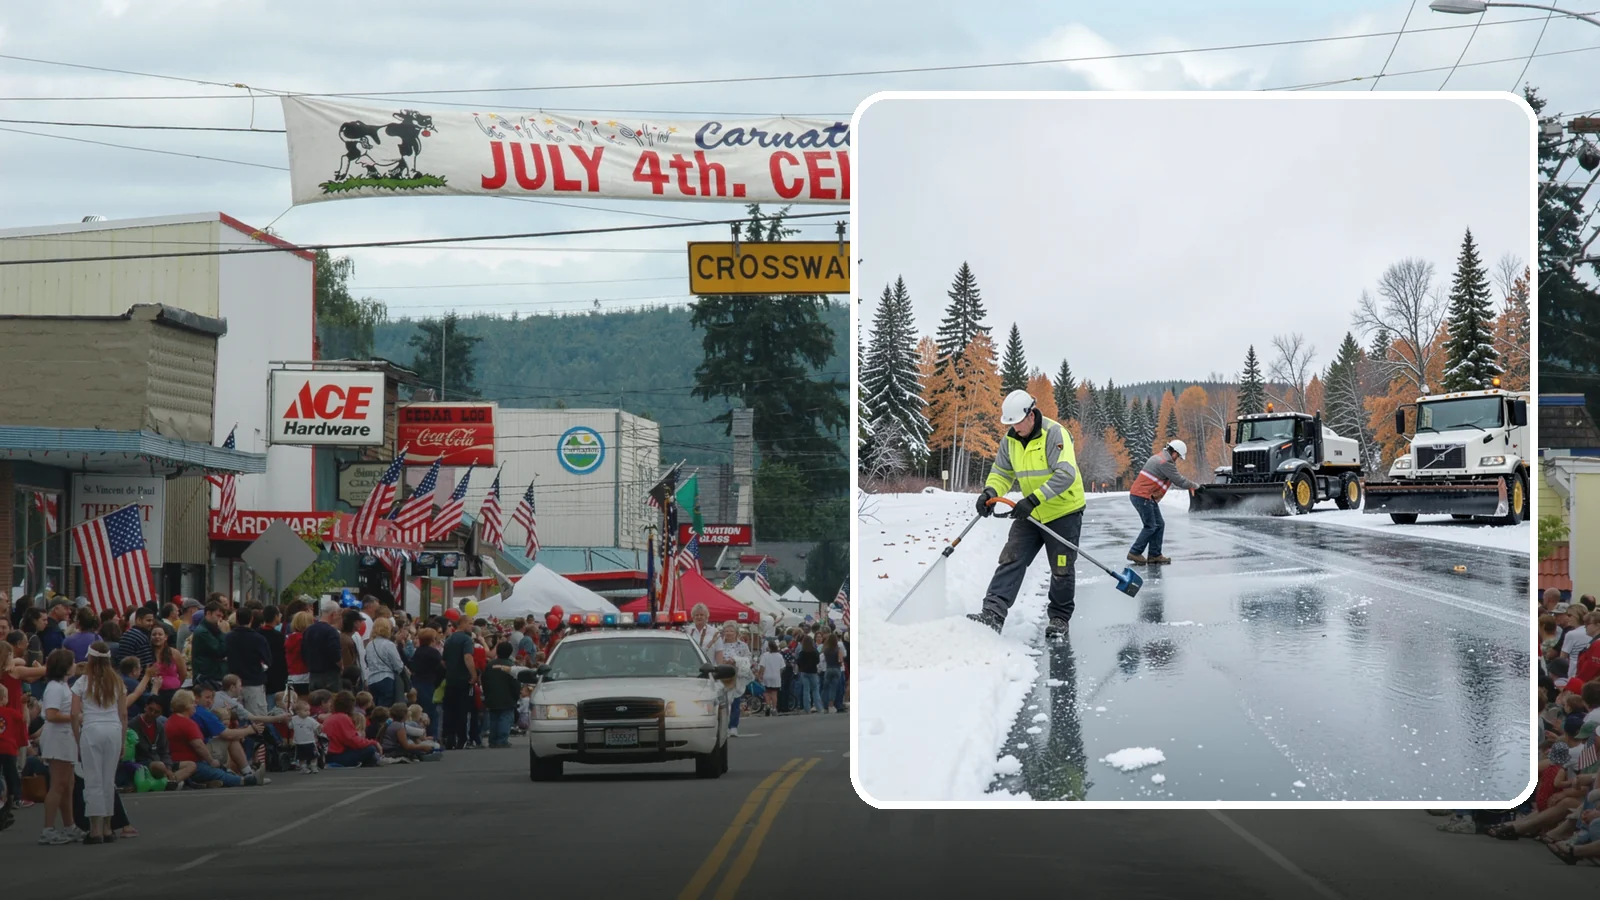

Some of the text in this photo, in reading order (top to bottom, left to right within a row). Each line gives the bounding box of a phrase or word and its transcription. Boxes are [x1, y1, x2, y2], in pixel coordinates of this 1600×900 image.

[481, 141, 604, 192] JULY
[632, 150, 747, 197] 4th.
[696, 254, 850, 280] CROSSWA
[282, 380, 373, 419] ACE
[406, 409, 452, 422] CEDAR
[283, 420, 371, 436] Hardware
[353, 466, 388, 481] Simpl
[125, 486, 136, 495] de
[137, 485, 155, 495] Paul
[212, 515, 331, 536] HARDARE
[687, 526, 741, 535] CRNATION
